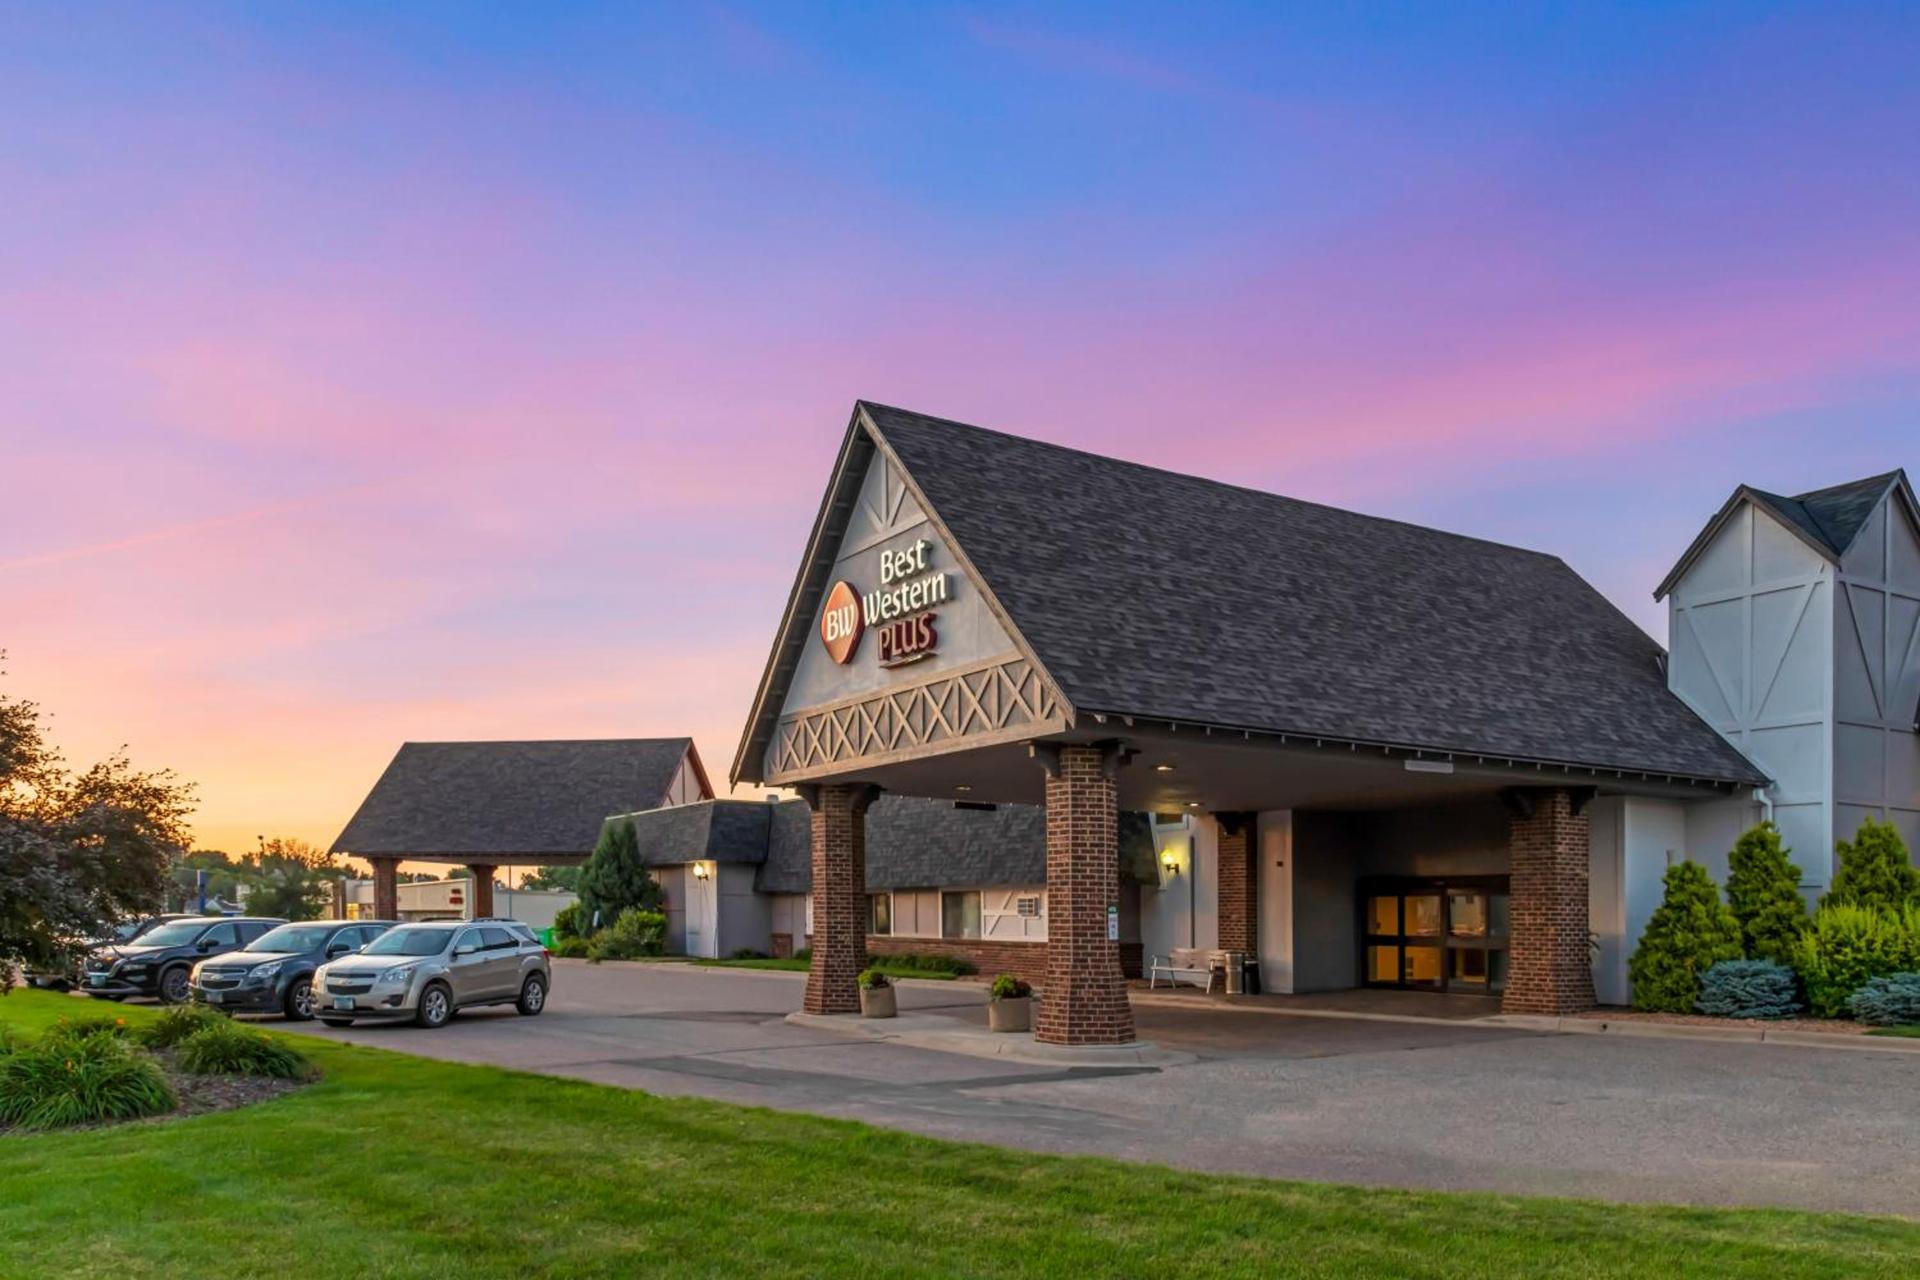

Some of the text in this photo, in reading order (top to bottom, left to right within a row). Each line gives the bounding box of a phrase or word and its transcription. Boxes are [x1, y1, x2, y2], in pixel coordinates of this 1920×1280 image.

[880, 539, 927, 585] Best
[826, 604, 855, 641] BW
[862, 572, 947, 627] Western
[879, 613, 934, 661] PLUS
